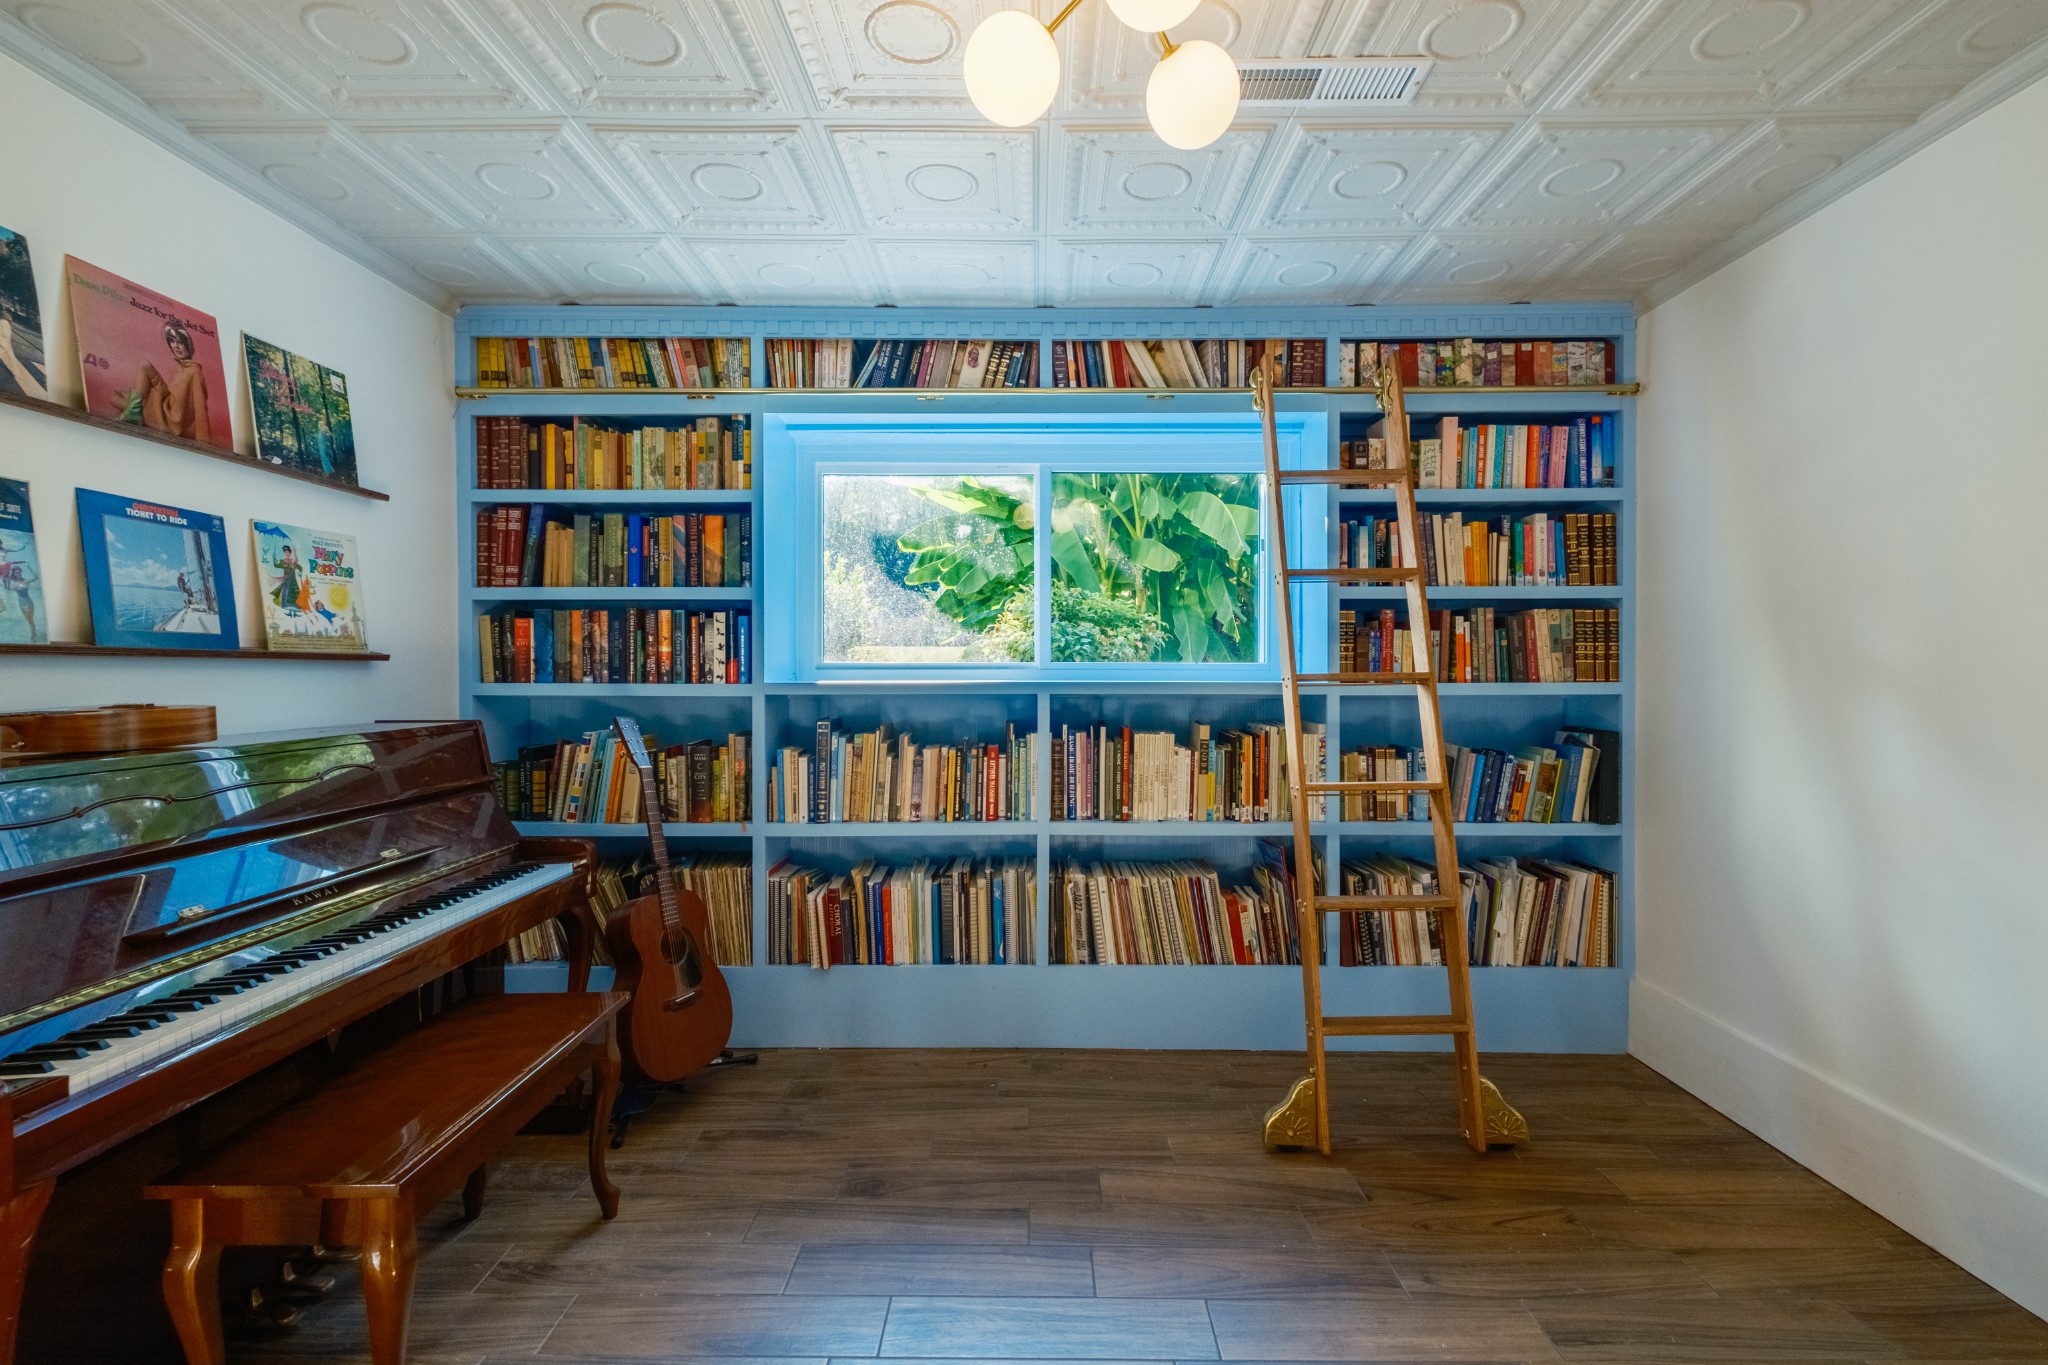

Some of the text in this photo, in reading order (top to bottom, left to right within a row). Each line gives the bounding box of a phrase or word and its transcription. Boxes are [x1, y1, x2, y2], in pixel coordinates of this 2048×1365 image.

[73, 273, 100, 294] Dave
[129, 298, 153, 314] Jazz
[154, 306, 168, 320] for
[168, 313, 184, 326] the
[184, 319, 199, 332] Jet
[199, 324, 216, 339] Set
[125, 507, 188, 526] TICKET TO RIDE
[132, 502, 179, 517] CARPENTERS
[690, 516, 698, 586] STEPHEN KING 11/22/63
[292, 886, 339, 906] KAWAI
[1075, 892, 1083, 911] JAZZ
[833, 904, 842, 936] CHORAL
